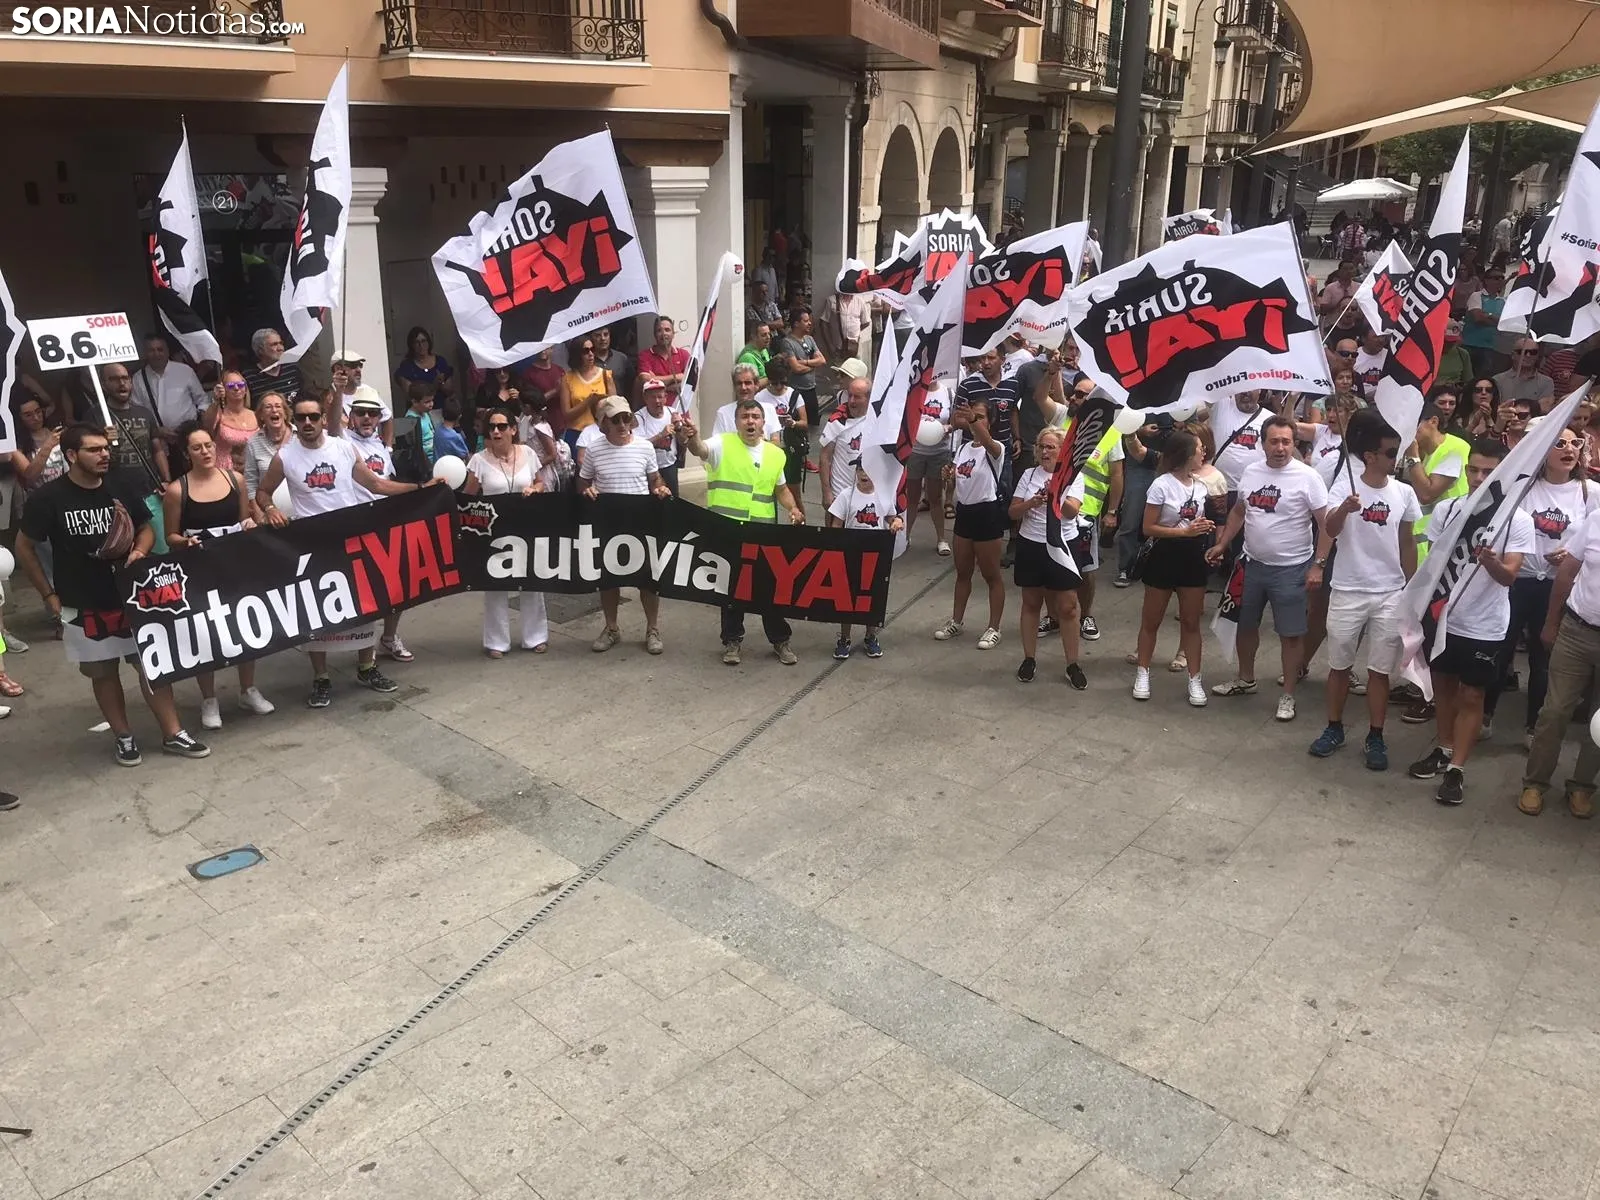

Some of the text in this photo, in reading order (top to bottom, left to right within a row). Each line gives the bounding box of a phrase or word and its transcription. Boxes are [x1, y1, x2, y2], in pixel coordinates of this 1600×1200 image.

[217, 196, 234, 208] 21
[928, 233, 974, 252] SORIA
[1560, 231, 1600, 251] #Soria
[86, 315, 127, 329] SORIA
[64, 506, 114, 536] DESAKA
[486, 524, 731, 596] autovía
[153, 572, 178, 588] SORIA
[138, 582, 184, 607] ¡YA!
[137, 553, 358, 681] autovía
